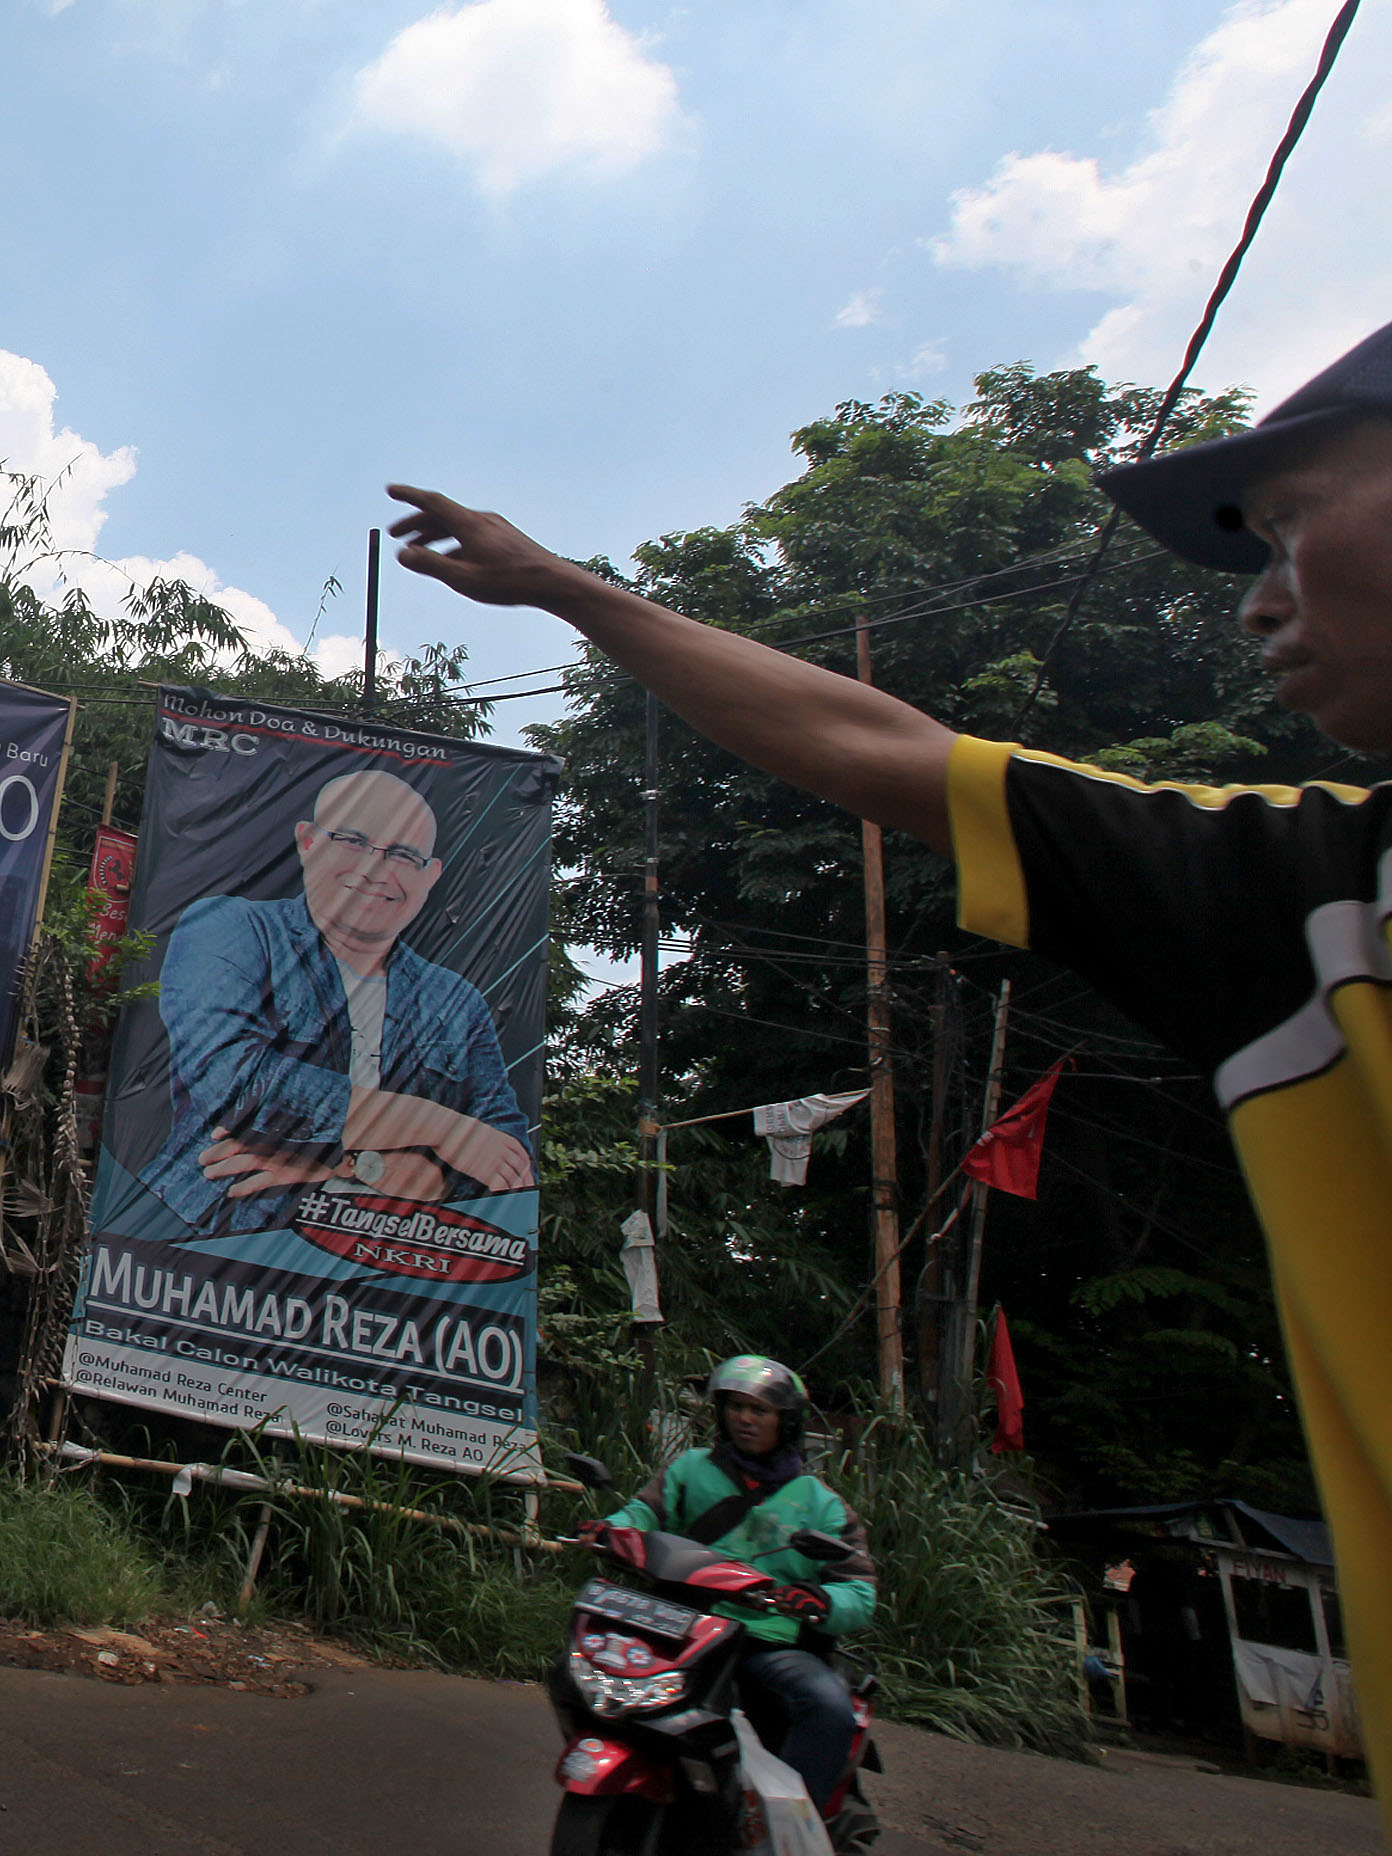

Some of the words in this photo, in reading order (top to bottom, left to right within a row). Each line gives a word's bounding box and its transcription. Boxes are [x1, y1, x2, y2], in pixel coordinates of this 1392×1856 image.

[164, 694, 244, 723] Mohon
[249, 706, 297, 733] Doa
[301, 720, 319, 738] &
[324, 725, 447, 760] Dukungan
[6, 742, 49, 768] Baru
[298, 1192, 526, 1260] #TangselBersama
[354, 1242, 451, 1274] NKRI
[90, 1247, 312, 1340] MUHAMAD
[322, 1294, 424, 1364] REZA
[435, 1315, 523, 1392] (AO)
[76, 1369, 157, 1398] @Relawan
[163, 1388, 239, 1415] Muhamad
[78, 1352, 171, 1384] @Muhamad
[177, 1373, 212, 1393] Reza
[218, 1382, 267, 1403] Center
[85, 1320, 166, 1350] Bakal
[176, 1340, 259, 1370] Calon
[266, 1358, 398, 1396] Walikota
[404, 1385, 523, 1423] Tangsel
[397, 1434, 416, 1449] M.
[421, 1438, 457, 1457] Reza
[462, 1446, 484, 1462] AO
[411, 1418, 487, 1445] Muhamad
